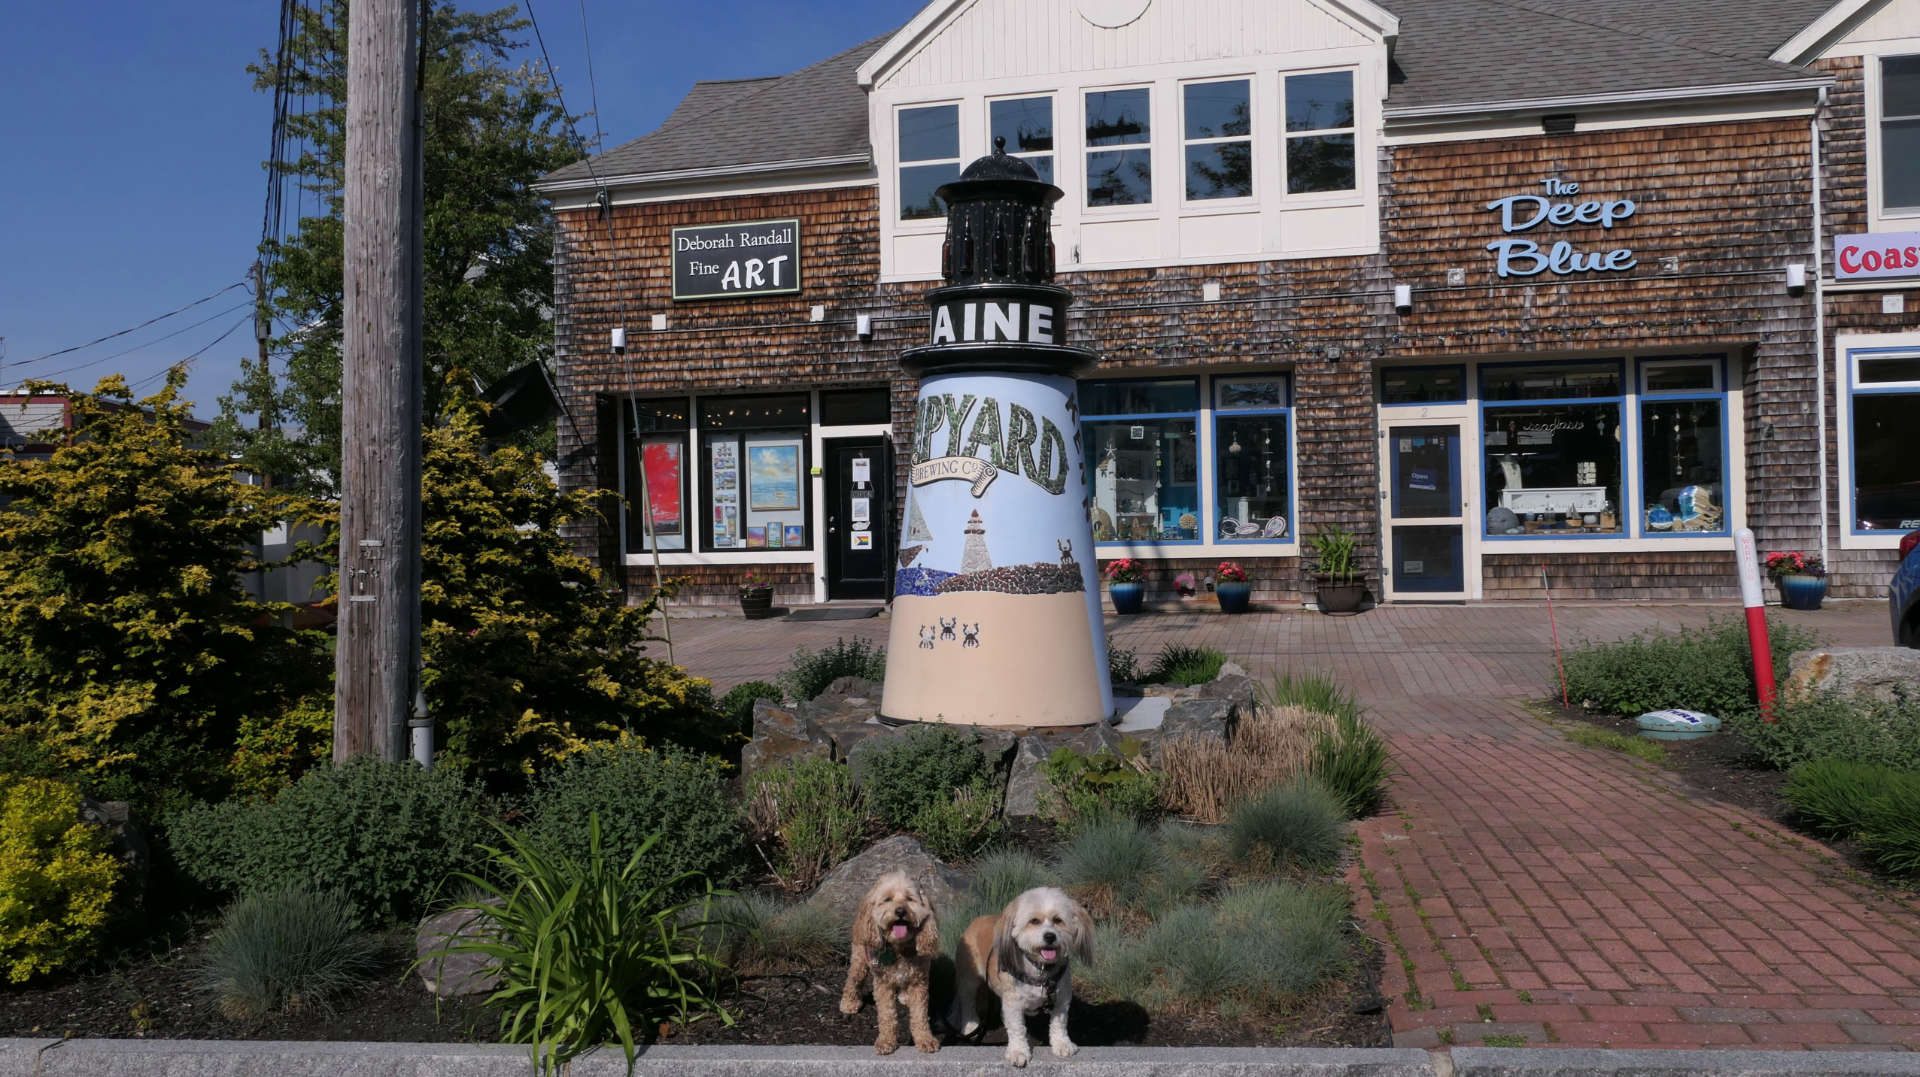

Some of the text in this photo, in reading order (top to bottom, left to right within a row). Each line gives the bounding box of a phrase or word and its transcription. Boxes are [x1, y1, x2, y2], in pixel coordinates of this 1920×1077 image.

[1540, 178, 1580, 196] The
[1487, 195, 1636, 233] Deep
[677, 228, 792, 252] Deborah Randall
[689, 255, 788, 290] Fine ART
[1486, 239, 1637, 278] Blue
[1839, 245, 1920, 274] Coas
[930, 302, 1053, 344] AINE
[914, 460, 959, 481] BREWING
